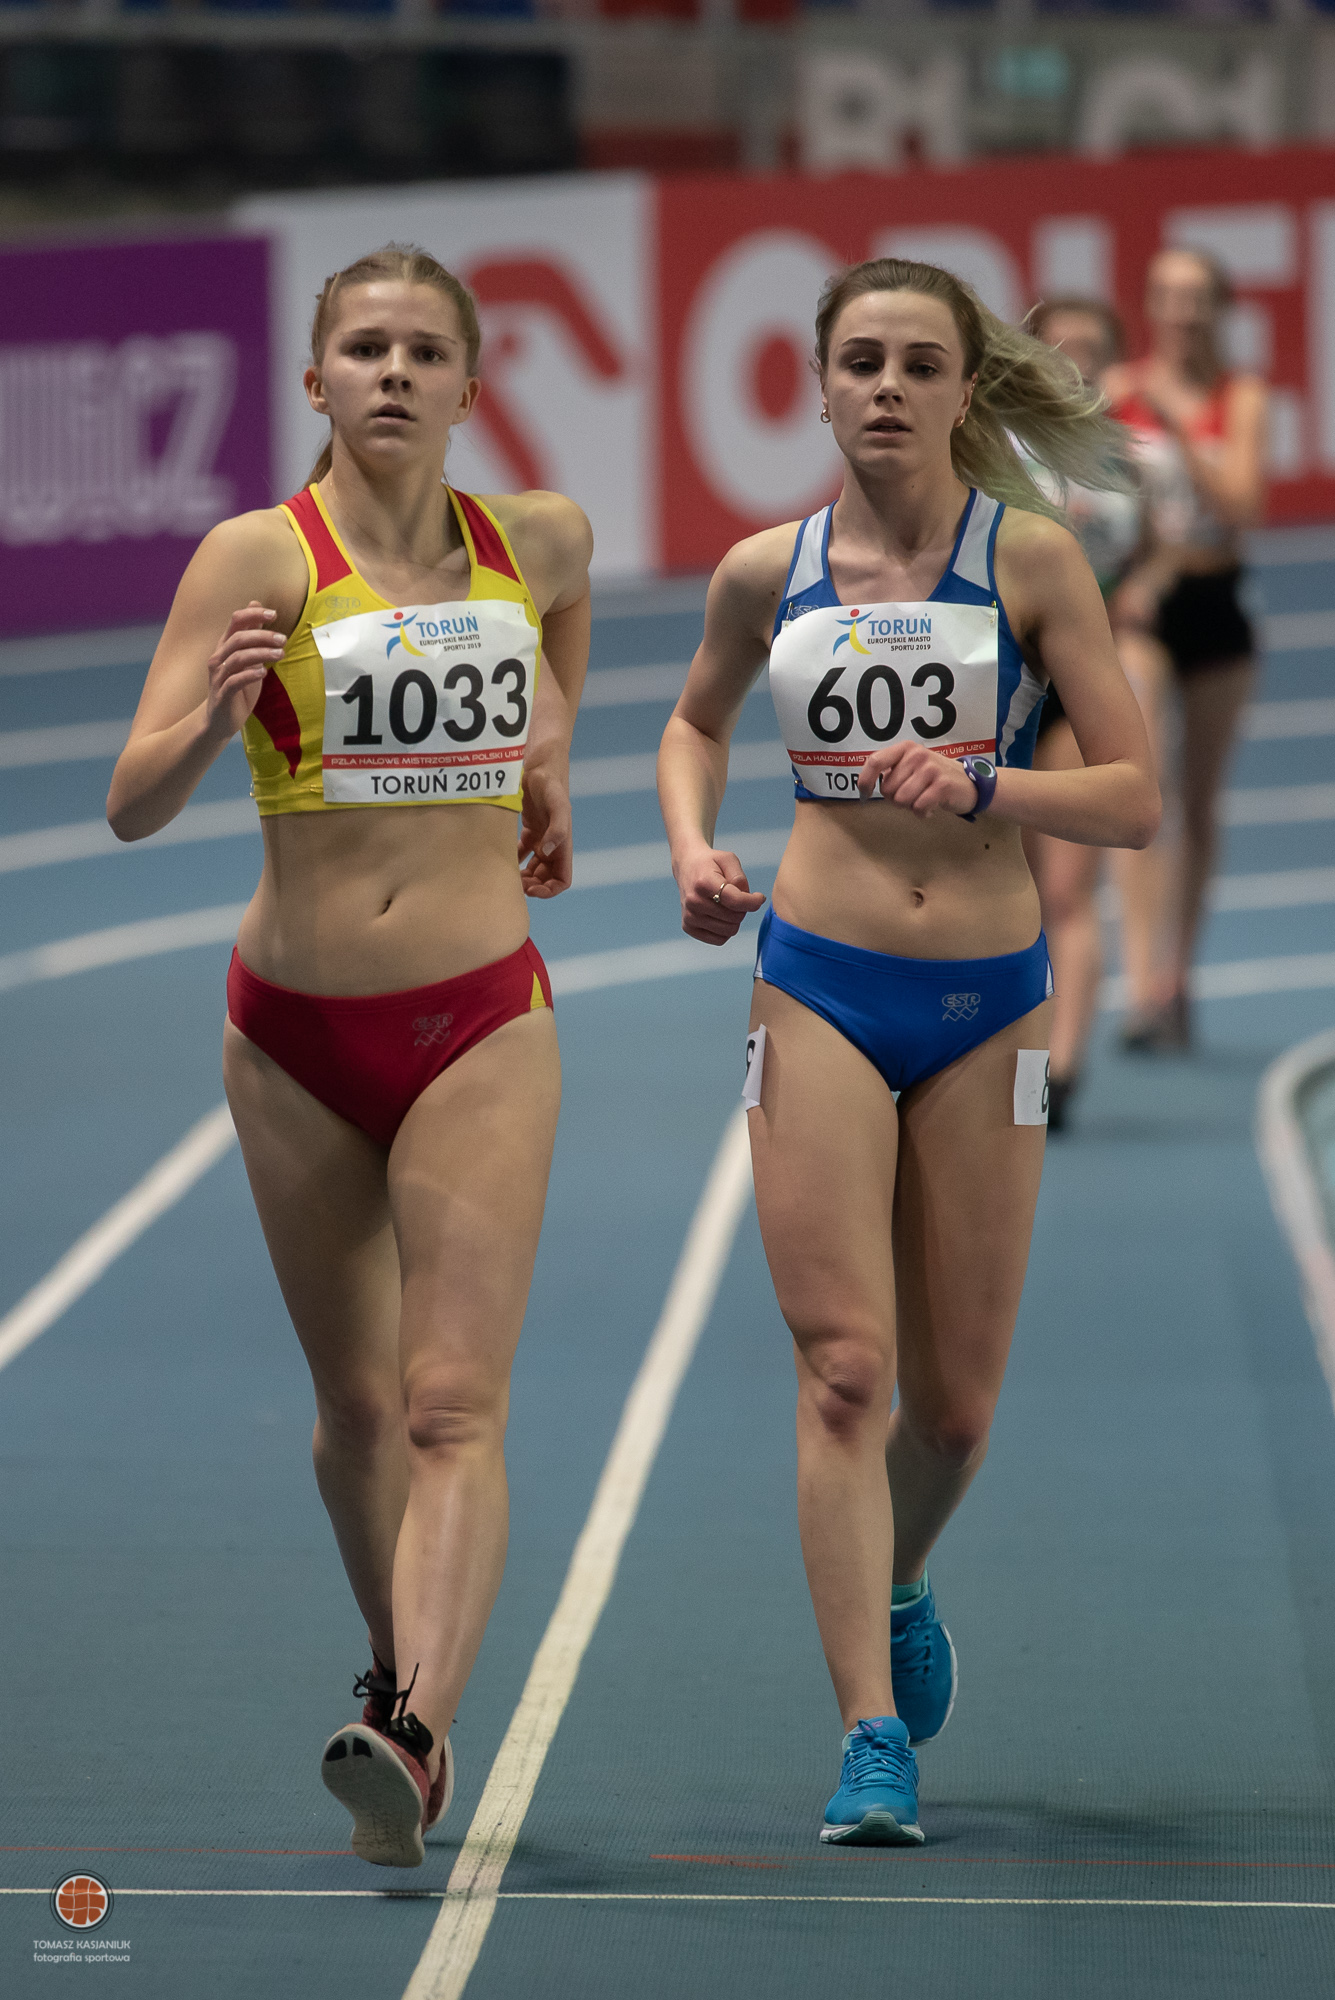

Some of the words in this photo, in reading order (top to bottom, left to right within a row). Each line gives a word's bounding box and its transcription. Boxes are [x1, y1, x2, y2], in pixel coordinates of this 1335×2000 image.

[415, 611, 479, 638] TORUŃ
[868, 612, 932, 636] TORUŃ
[419, 636, 457, 646] EUROPEJSKIE
[443, 643, 466, 652] SPORTU
[467, 642, 482, 650] 2019
[908, 635, 931, 643] MIASTO
[340, 658, 527, 746] 1033
[807, 662, 957, 743] 603
[331, 757, 357, 766] PZLA
[359, 757, 400, 765] HALOWE
[401, 754, 470, 765] MISTRZOSTWA
[471, 752, 503, 762] POLSKI
[504, 750, 519, 758] U18
[793, 753, 813, 762] PZLA
[813, 755, 846, 763] HALOWE
[949, 747, 965, 755] U18
[966, 743, 985, 752] U20
[370, 768, 448, 795] TORUŃ
[456, 770, 506, 792] 2019
[825, 772, 884, 792] TOR
